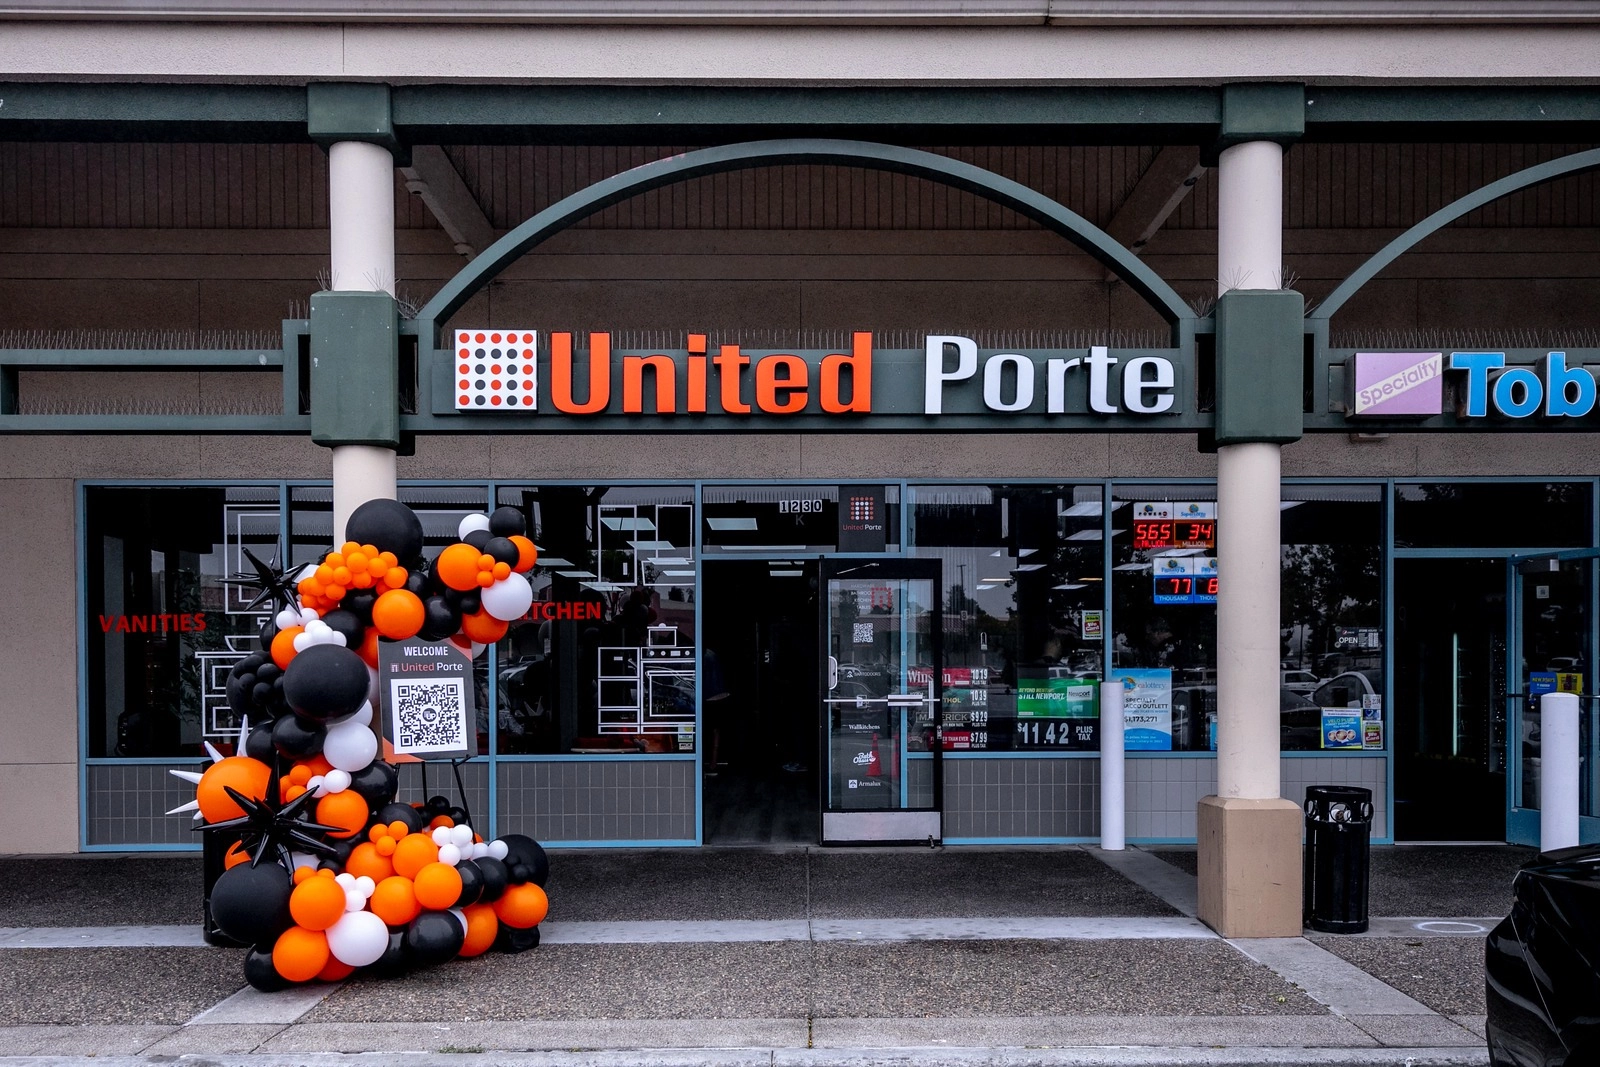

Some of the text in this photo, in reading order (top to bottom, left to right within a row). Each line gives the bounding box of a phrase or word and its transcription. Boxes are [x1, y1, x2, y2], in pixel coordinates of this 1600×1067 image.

[550, 332, 1175, 415] United Porte
[1360, 359, 1438, 405] Specialty
[1450, 351, 1600, 418] Tob
[780, 500, 823, 512] 1230
[1136, 523, 1171, 539] 565
[1188, 523, 1212, 539] 34
[1170, 578, 1192, 594] 77
[517, 601, 601, 620] TCHEN
[98, 612, 208, 633] VANITIES
[403, 646, 448, 656] WELCOME
[401, 662, 463, 672] United Porte
[907, 669, 951, 683] Winsn
[1017, 722, 1069, 744] $11.42
[1078, 733, 1091, 741] TAX
